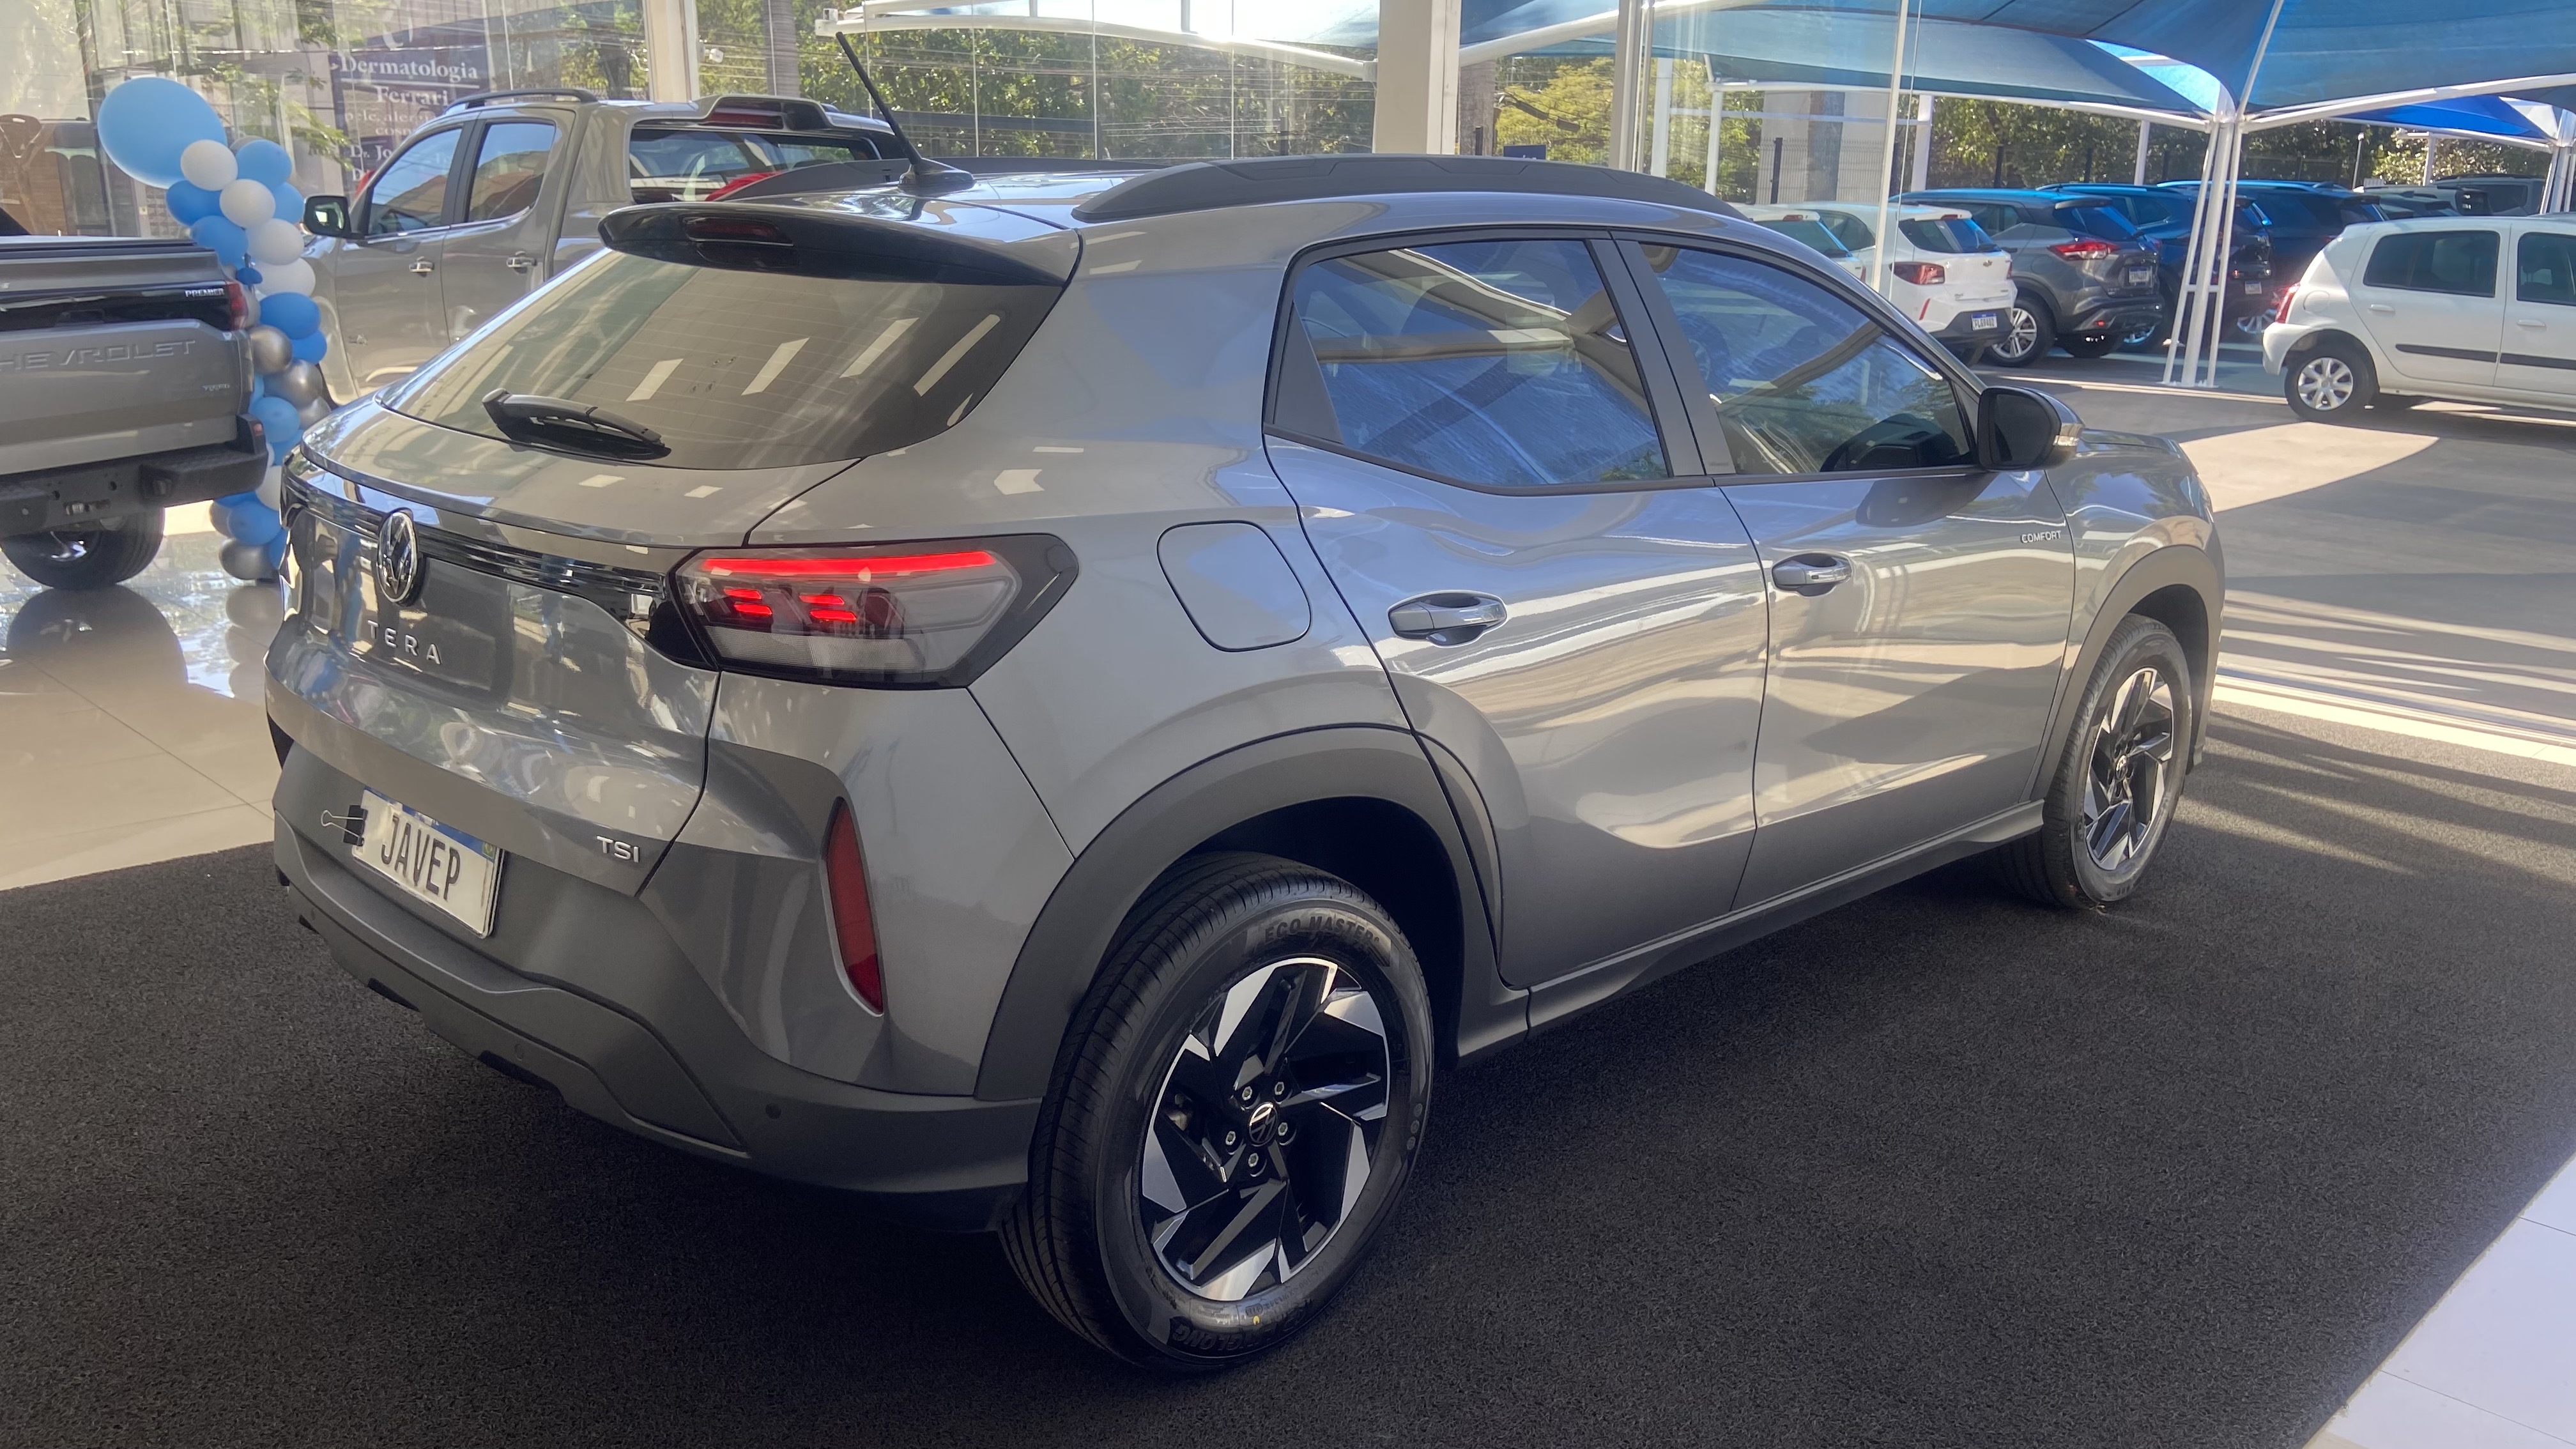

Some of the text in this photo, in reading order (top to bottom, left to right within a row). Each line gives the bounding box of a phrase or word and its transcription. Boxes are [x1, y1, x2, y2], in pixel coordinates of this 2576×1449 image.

[339, 55, 479, 83] Dermatologia
[373, 85, 448, 107] Ferrari
[185, 288, 224, 298] PREMIER
[2021, 530, 2062, 544] COMFORT
[367, 620, 441, 665] TERA
[380, 815, 461, 901] JAVEP
[597, 835, 640, 864] TSI
[1264, 918, 1301, 943] ECO
